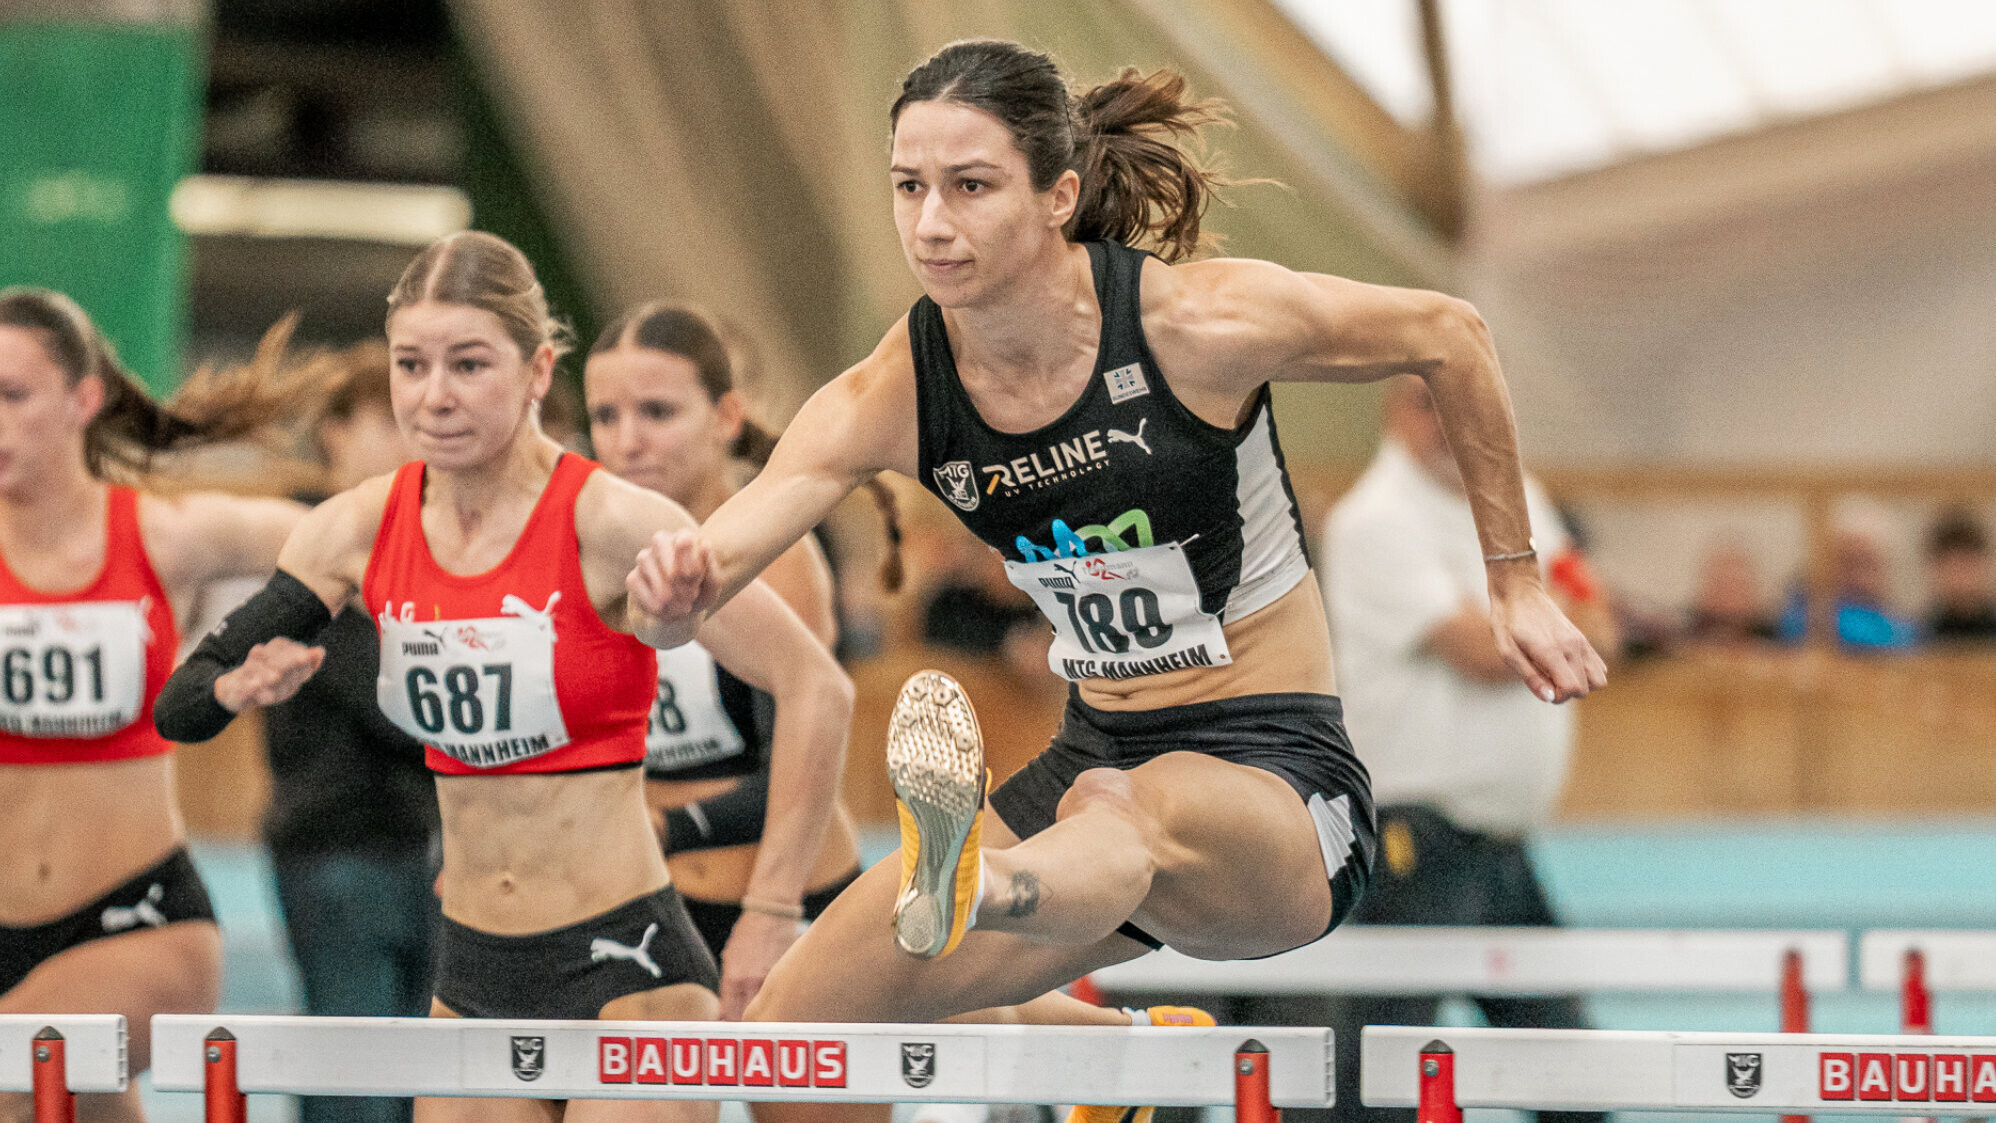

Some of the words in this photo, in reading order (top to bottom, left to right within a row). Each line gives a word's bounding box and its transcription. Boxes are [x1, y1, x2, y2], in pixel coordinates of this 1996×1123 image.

[982, 429, 1107, 495] RELINE
[1004, 488, 1020, 497] UV
[3, 644, 103, 704] 691
[1063, 658, 1097, 679] MTG
[1101, 644, 1213, 680] MANNHEIM
[405, 663, 512, 735] 687
[603, 1041, 844, 1080] BAUHAUS
[1824, 1058, 1996, 1094] BAUHA
